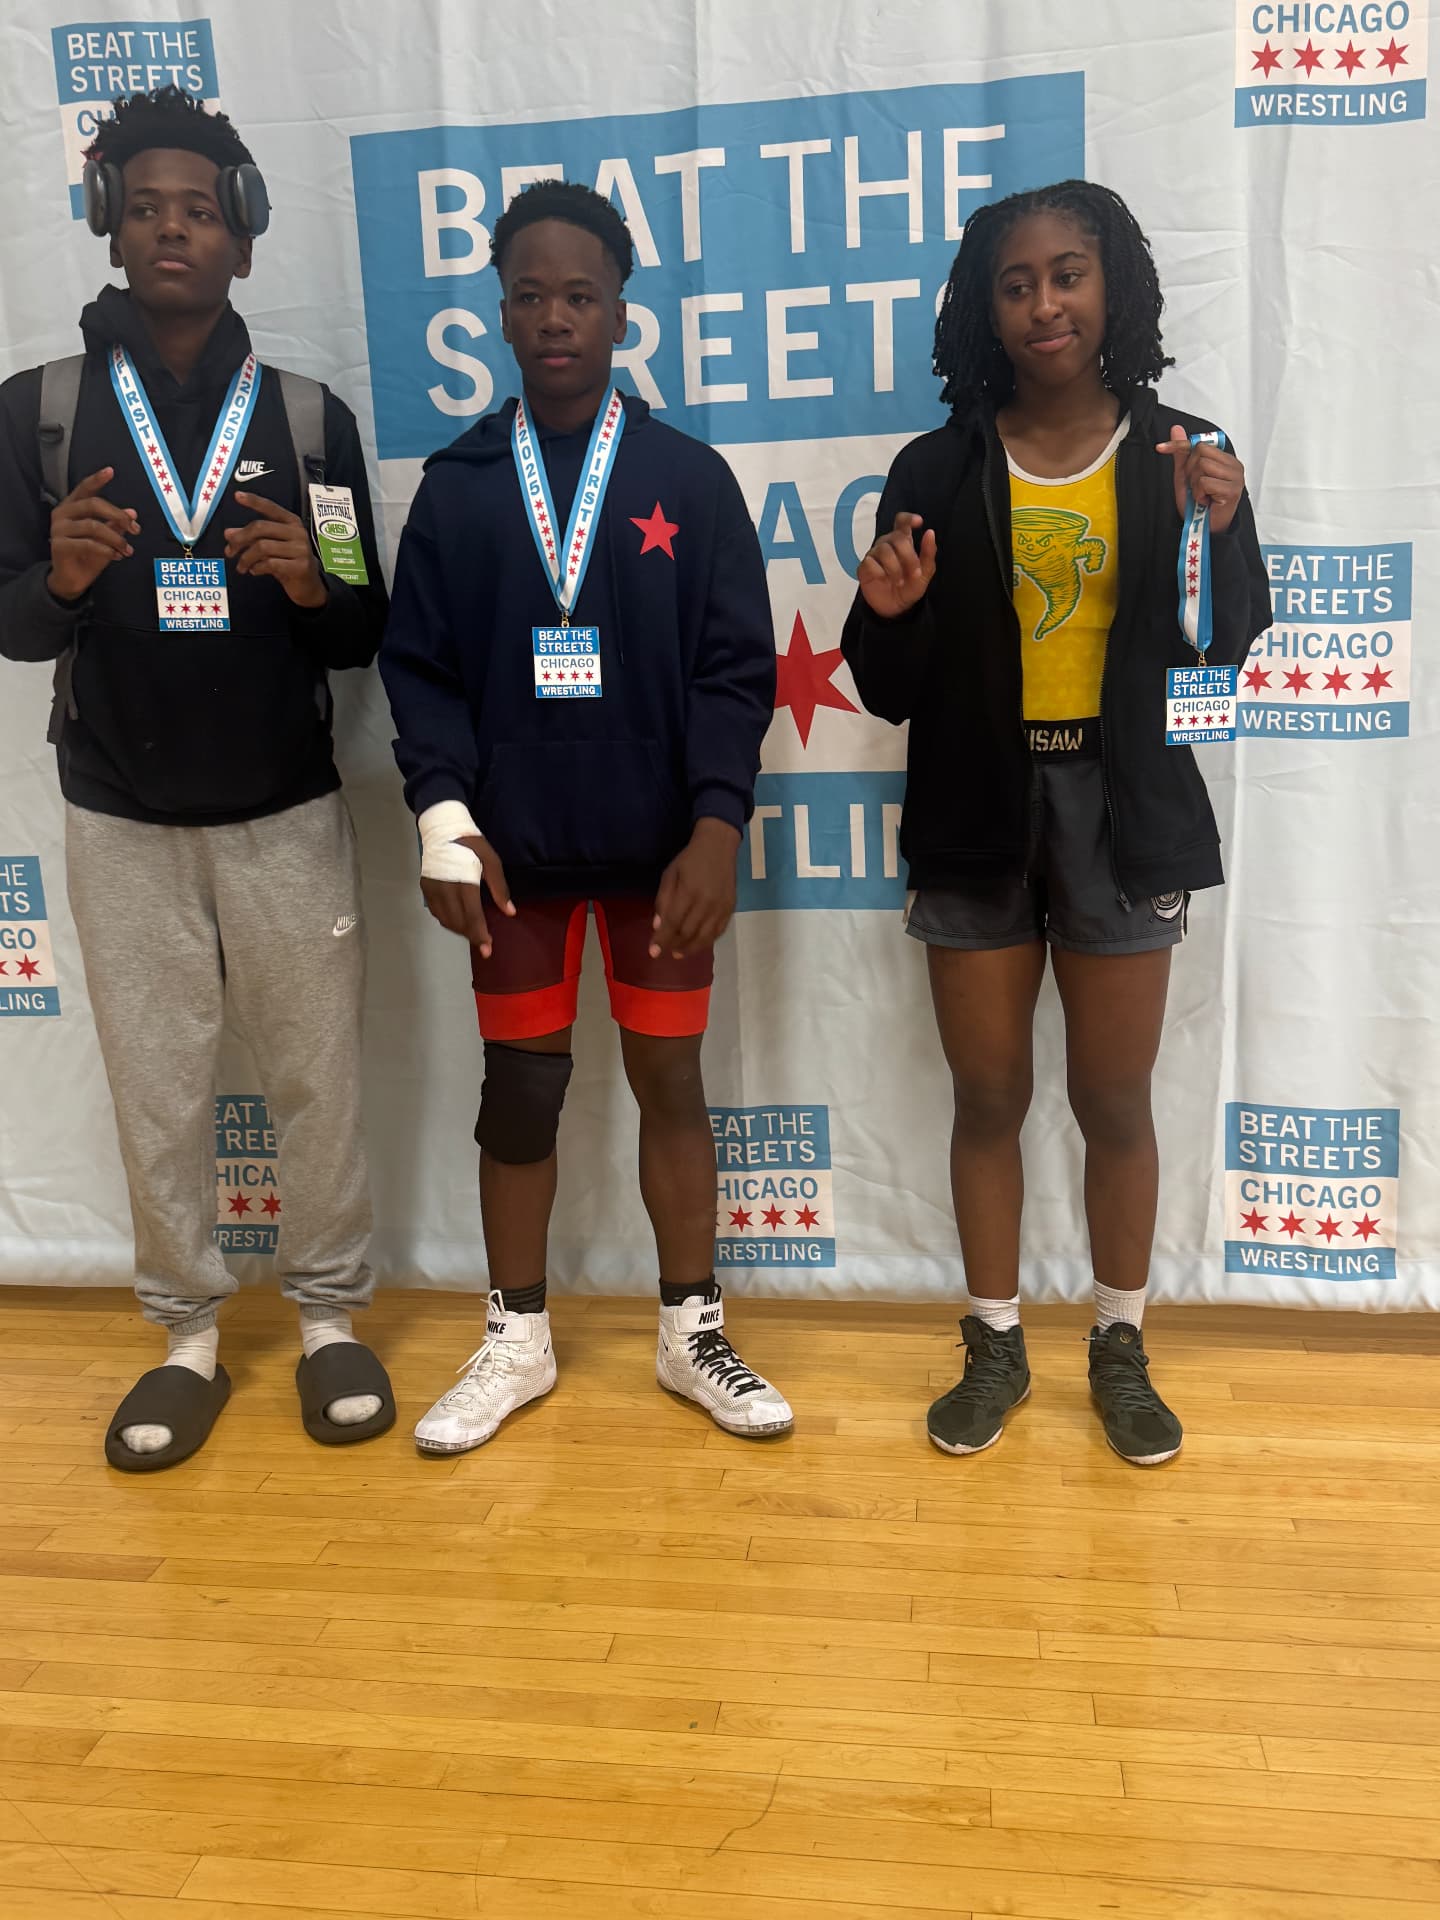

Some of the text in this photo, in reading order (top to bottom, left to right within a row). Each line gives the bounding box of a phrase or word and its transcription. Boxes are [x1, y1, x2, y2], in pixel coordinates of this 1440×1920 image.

[1252, 0, 1410, 35] CHICAGO
[67, 30, 201, 61] BEAT THE
[71, 64, 204, 93] STREETS
[1250, 90, 1408, 118] WRESTLING
[760, 123, 1006, 255] THE
[426, 277, 949, 418] SREET
[116, 360, 150, 440] FIRST
[223, 381, 252, 441] 2025
[240, 460, 266, 473] NIKE
[518, 429, 541, 496] 2025
[579, 441, 609, 524] FIRST
[316, 503, 353, 521] STATE FINAL
[161, 562, 219, 573] BEAT THE
[1266, 552, 1395, 583] EAT THE
[162, 574, 220, 585] STREETS
[163, 590, 222, 601] CHICAGO
[1268, 586, 1394, 616] TREETS
[166, 619, 224, 629] WRESTLING
[538, 630, 593, 641] BEAT THE
[539, 642, 594, 653] STREETS
[540, 657, 595, 669] CHICAGO
[1174, 669, 1232, 683] BEAT THE
[541, 686, 596, 696] WRESTLING
[1173, 682, 1231, 697] STREETS
[1173, 699, 1231, 713] CHICAGO
[1242, 709, 1392, 732] WRESTLING
[1172, 730, 1230, 742] WRESTLING
[709, 1112, 815, 1137] EAT THE
[1239, 1110, 1383, 1141] BEAT THE
[714, 1140, 816, 1164] TREETS
[1239, 1139, 1382, 1171] STREETS
[216, 1164, 278, 1187] HICA
[717, 1176, 819, 1201] HICAGO
[1240, 1178, 1382, 1210] CHICAGO
[213, 1230, 278, 1249] RESTL
[718, 1243, 822, 1262] RESTLING
[1239, 1247, 1380, 1275] WRESTLING
[487, 1319, 507, 1335] NIKE
[697, 1308, 720, 1325] NIKE
